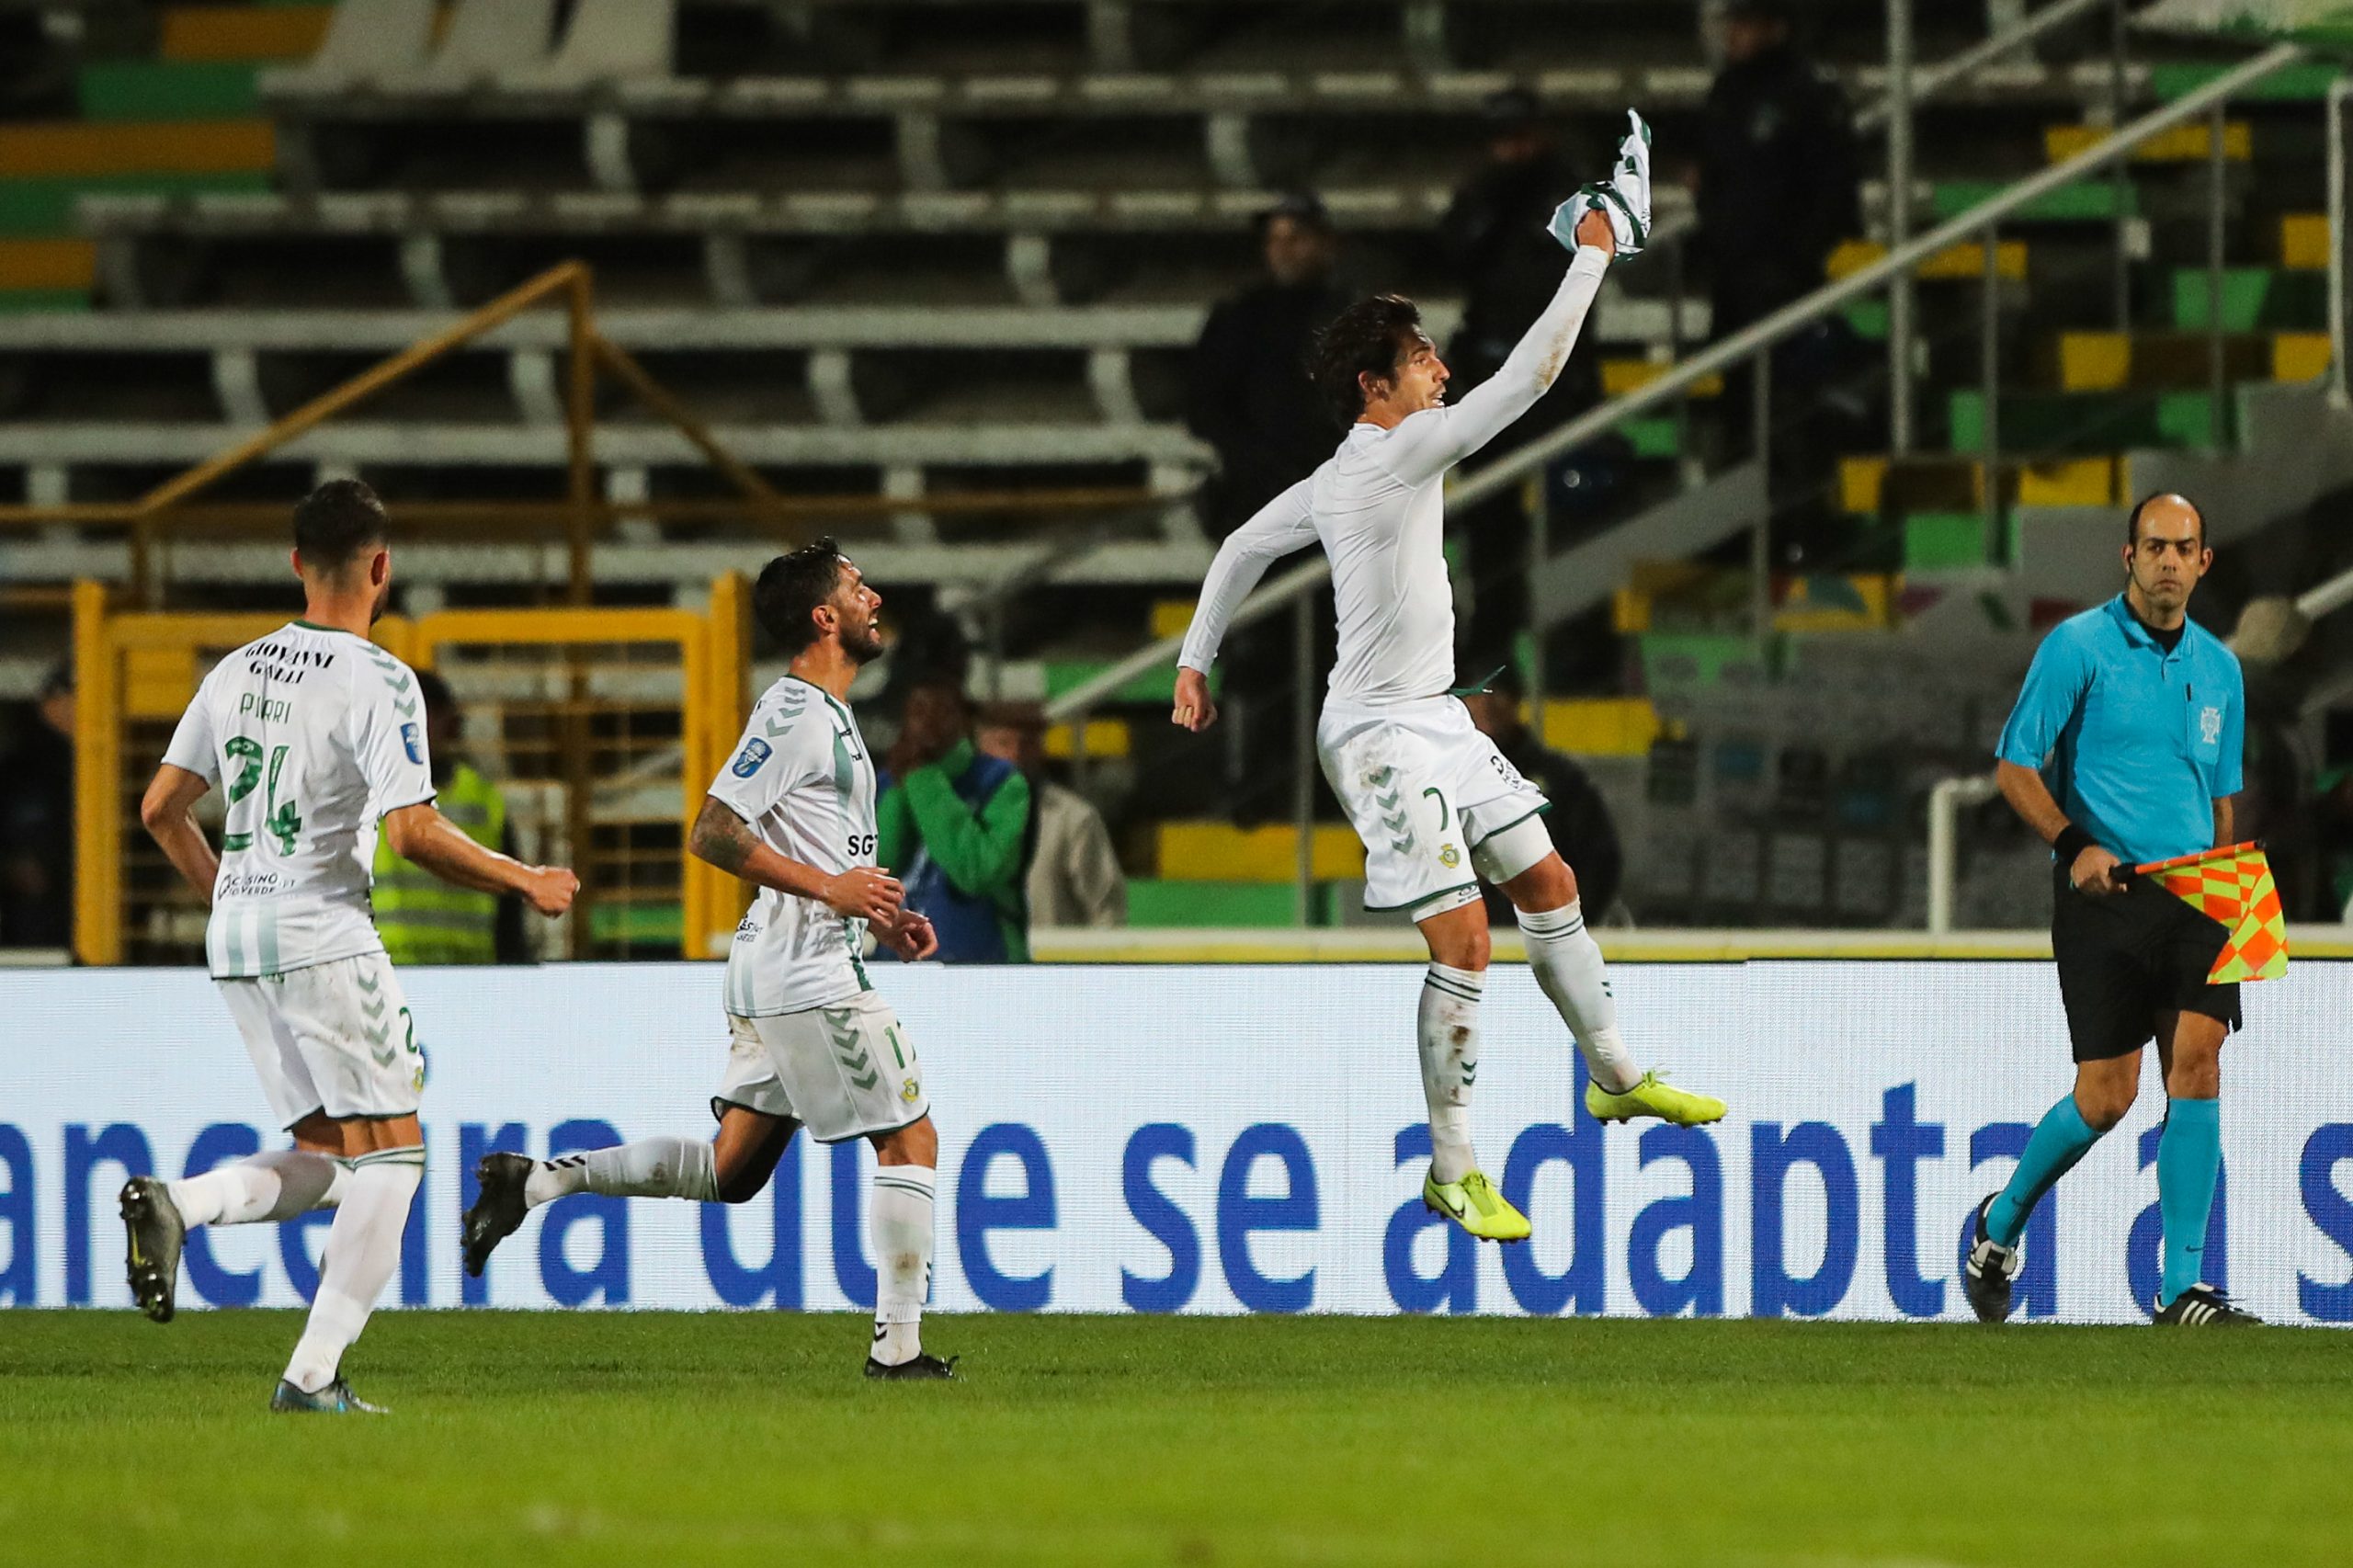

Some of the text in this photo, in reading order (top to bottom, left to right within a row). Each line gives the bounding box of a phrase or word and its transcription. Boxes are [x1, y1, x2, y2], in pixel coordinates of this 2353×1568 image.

[245, 642, 335, 669] GIOVANNI
[249, 660, 305, 684] GALLI
[240, 692, 292, 724] PIRRI
[223, 735, 302, 857] 24
[1423, 787, 1449, 832] 7
[847, 834, 879, 857] SG
[884, 1019, 916, 1070] 1
[1121, 1122, 1320, 1313] se
[1382, 1043, 2059, 1317] adapta
